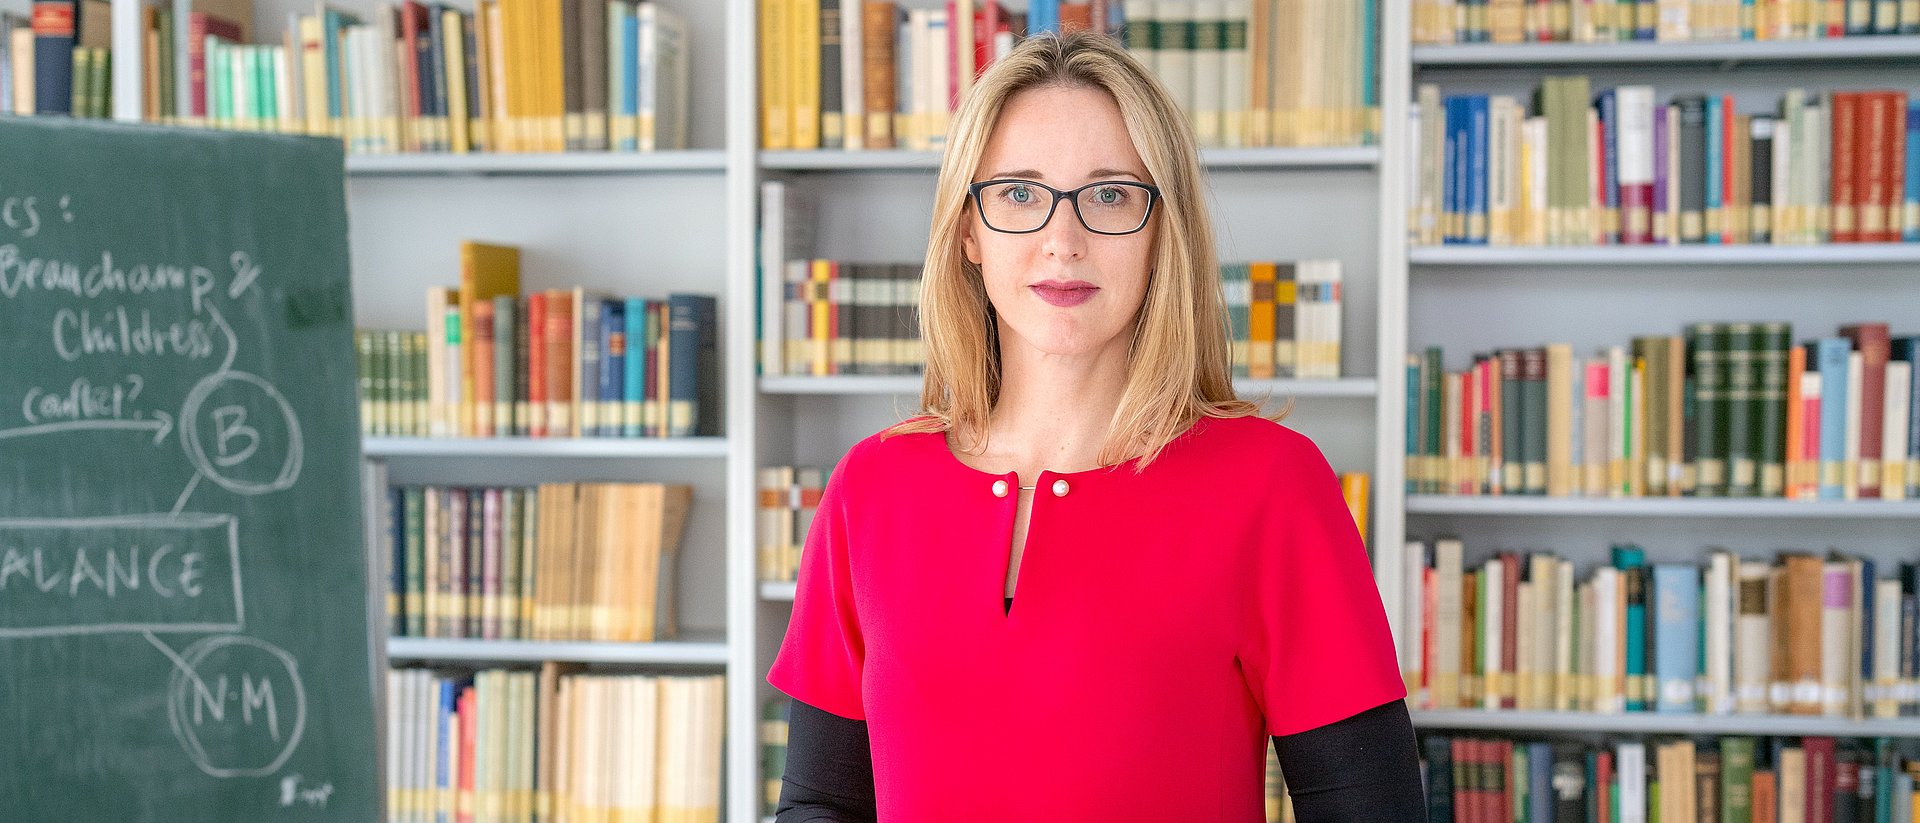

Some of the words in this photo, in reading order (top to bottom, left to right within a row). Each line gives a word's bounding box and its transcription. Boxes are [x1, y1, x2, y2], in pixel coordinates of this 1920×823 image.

[0, 243, 215, 315] Beauchamp
[53, 304, 213, 361] Childress
[211, 405, 260, 466] B
[0, 544, 201, 598] ALANCE
